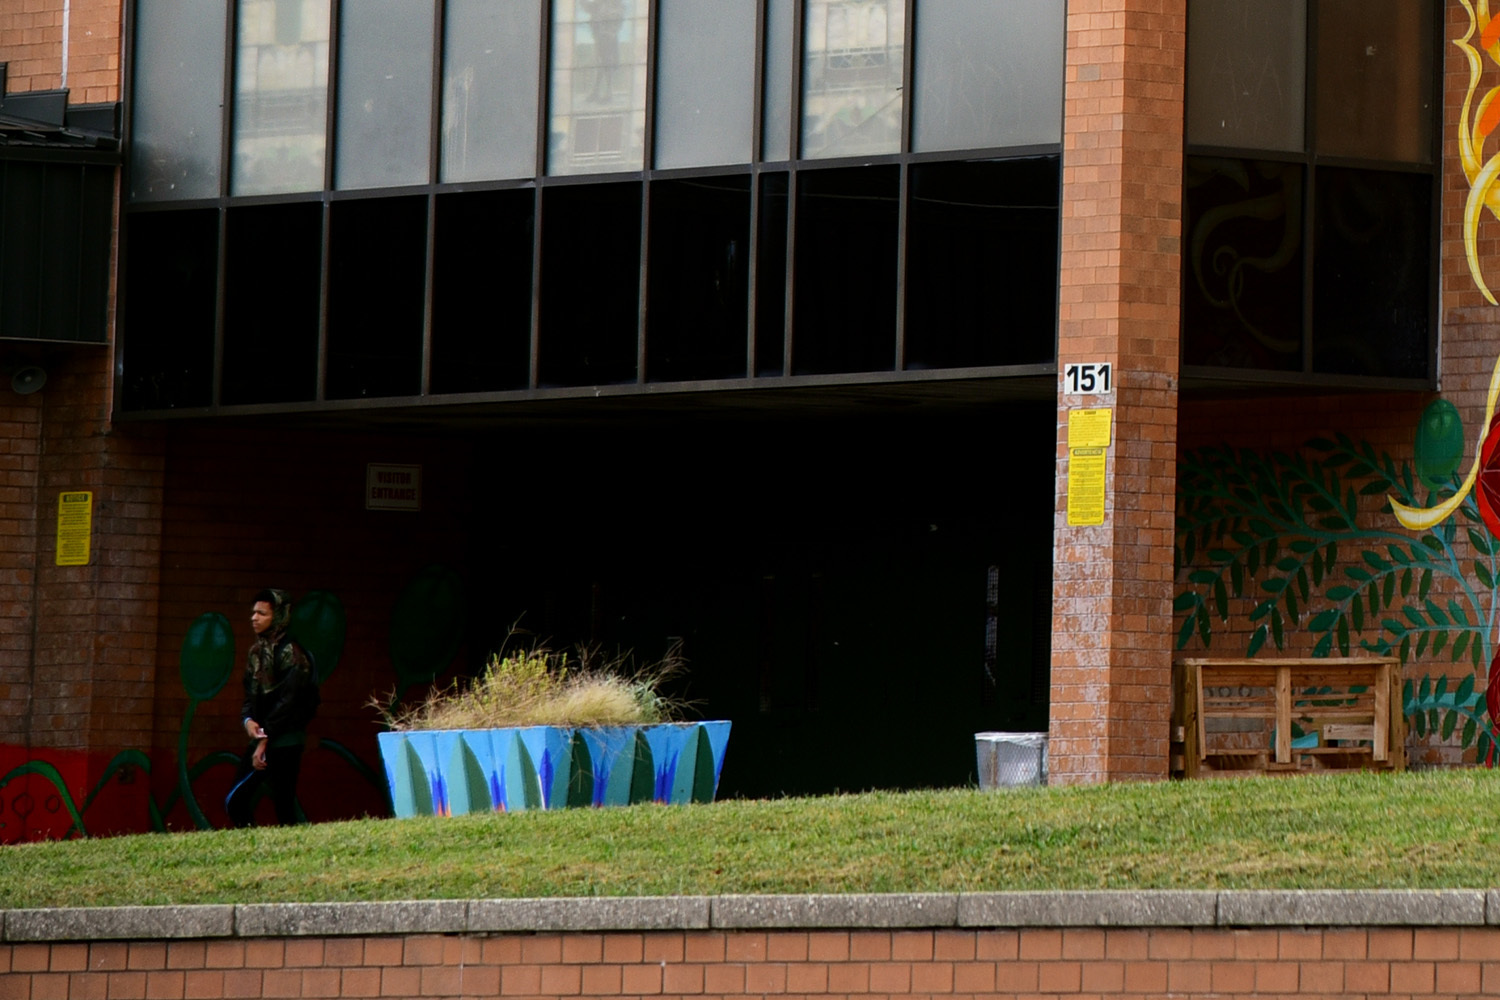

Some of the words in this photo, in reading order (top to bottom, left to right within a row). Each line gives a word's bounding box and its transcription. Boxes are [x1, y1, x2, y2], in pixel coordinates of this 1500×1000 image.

[1066, 365, 1110, 392] 151
[377, 472, 412, 484] VISITOR
[371, 487, 417, 501] ENTRANCE
